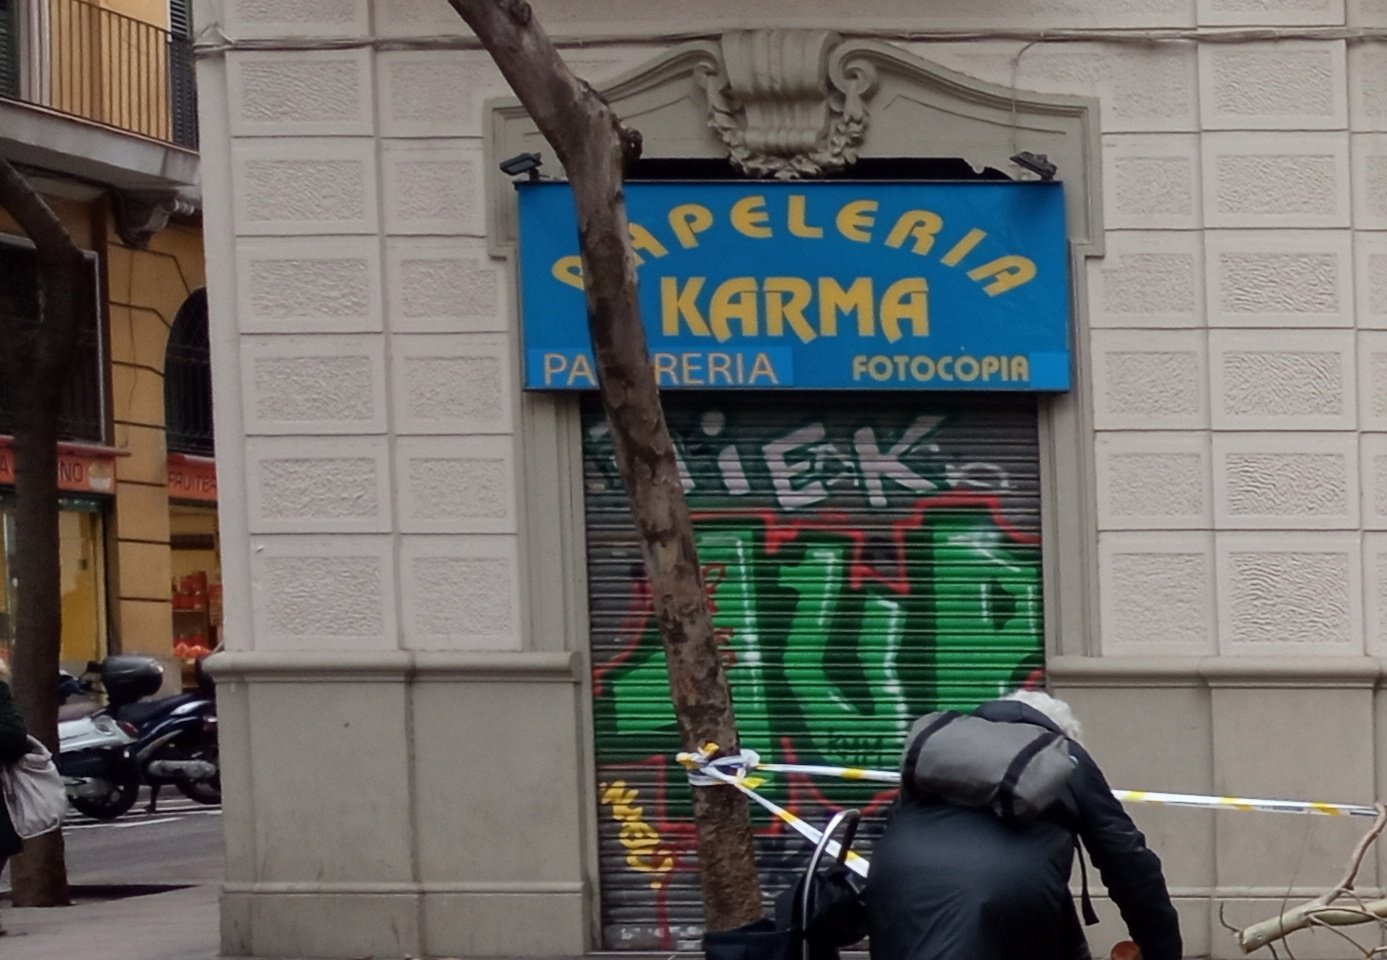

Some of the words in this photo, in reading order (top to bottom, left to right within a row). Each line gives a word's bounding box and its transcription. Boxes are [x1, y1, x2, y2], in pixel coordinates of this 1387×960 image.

[659, 276, 931, 344] KARMA
[543, 352, 780, 386] PARERIA
[851, 354, 1031, 383] FOTOCOPIA
